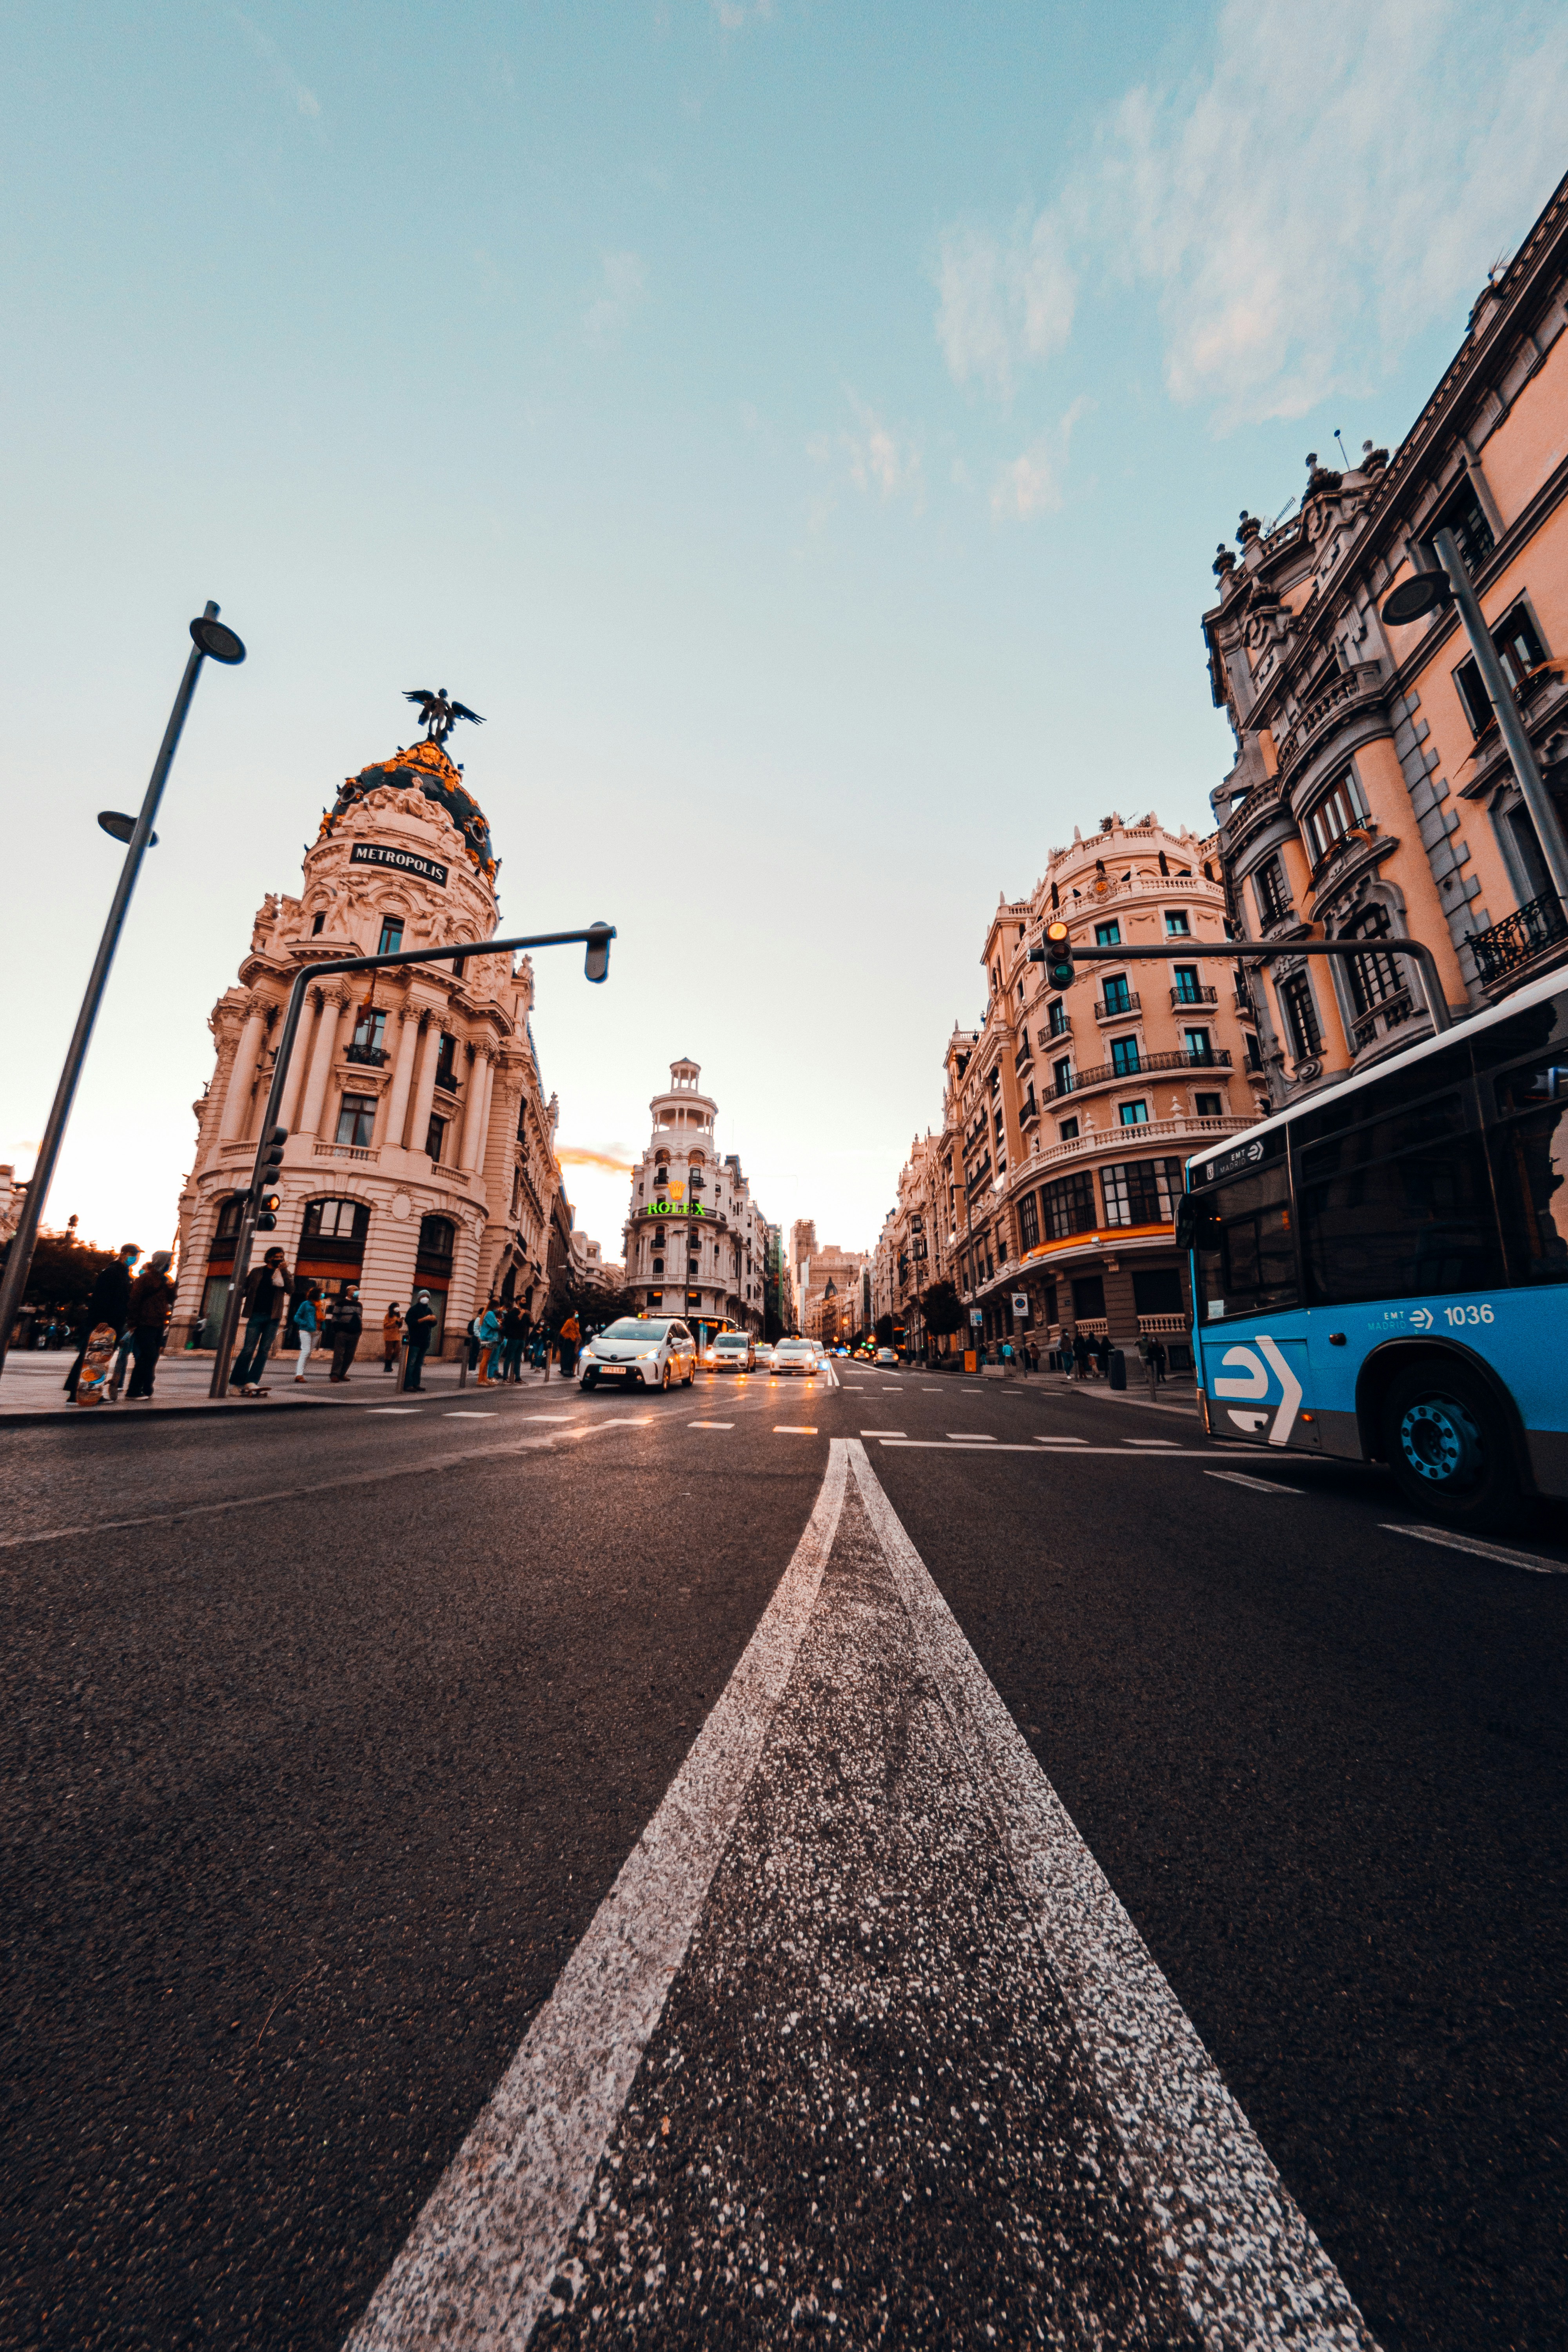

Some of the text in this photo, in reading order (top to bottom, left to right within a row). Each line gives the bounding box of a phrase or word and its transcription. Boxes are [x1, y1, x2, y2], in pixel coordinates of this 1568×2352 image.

[356, 848, 444, 880] METROPOLIS
[1231, 1149, 1245, 1161] EMT
[1220, 1158, 1246, 1173] MADRID
[647, 1201, 706, 1216] ROLEX
[1384, 1311, 1404, 1320] EMT
[1444, 1304, 1495, 1326] 1036
[1368, 1321, 1406, 1330] MADRID
